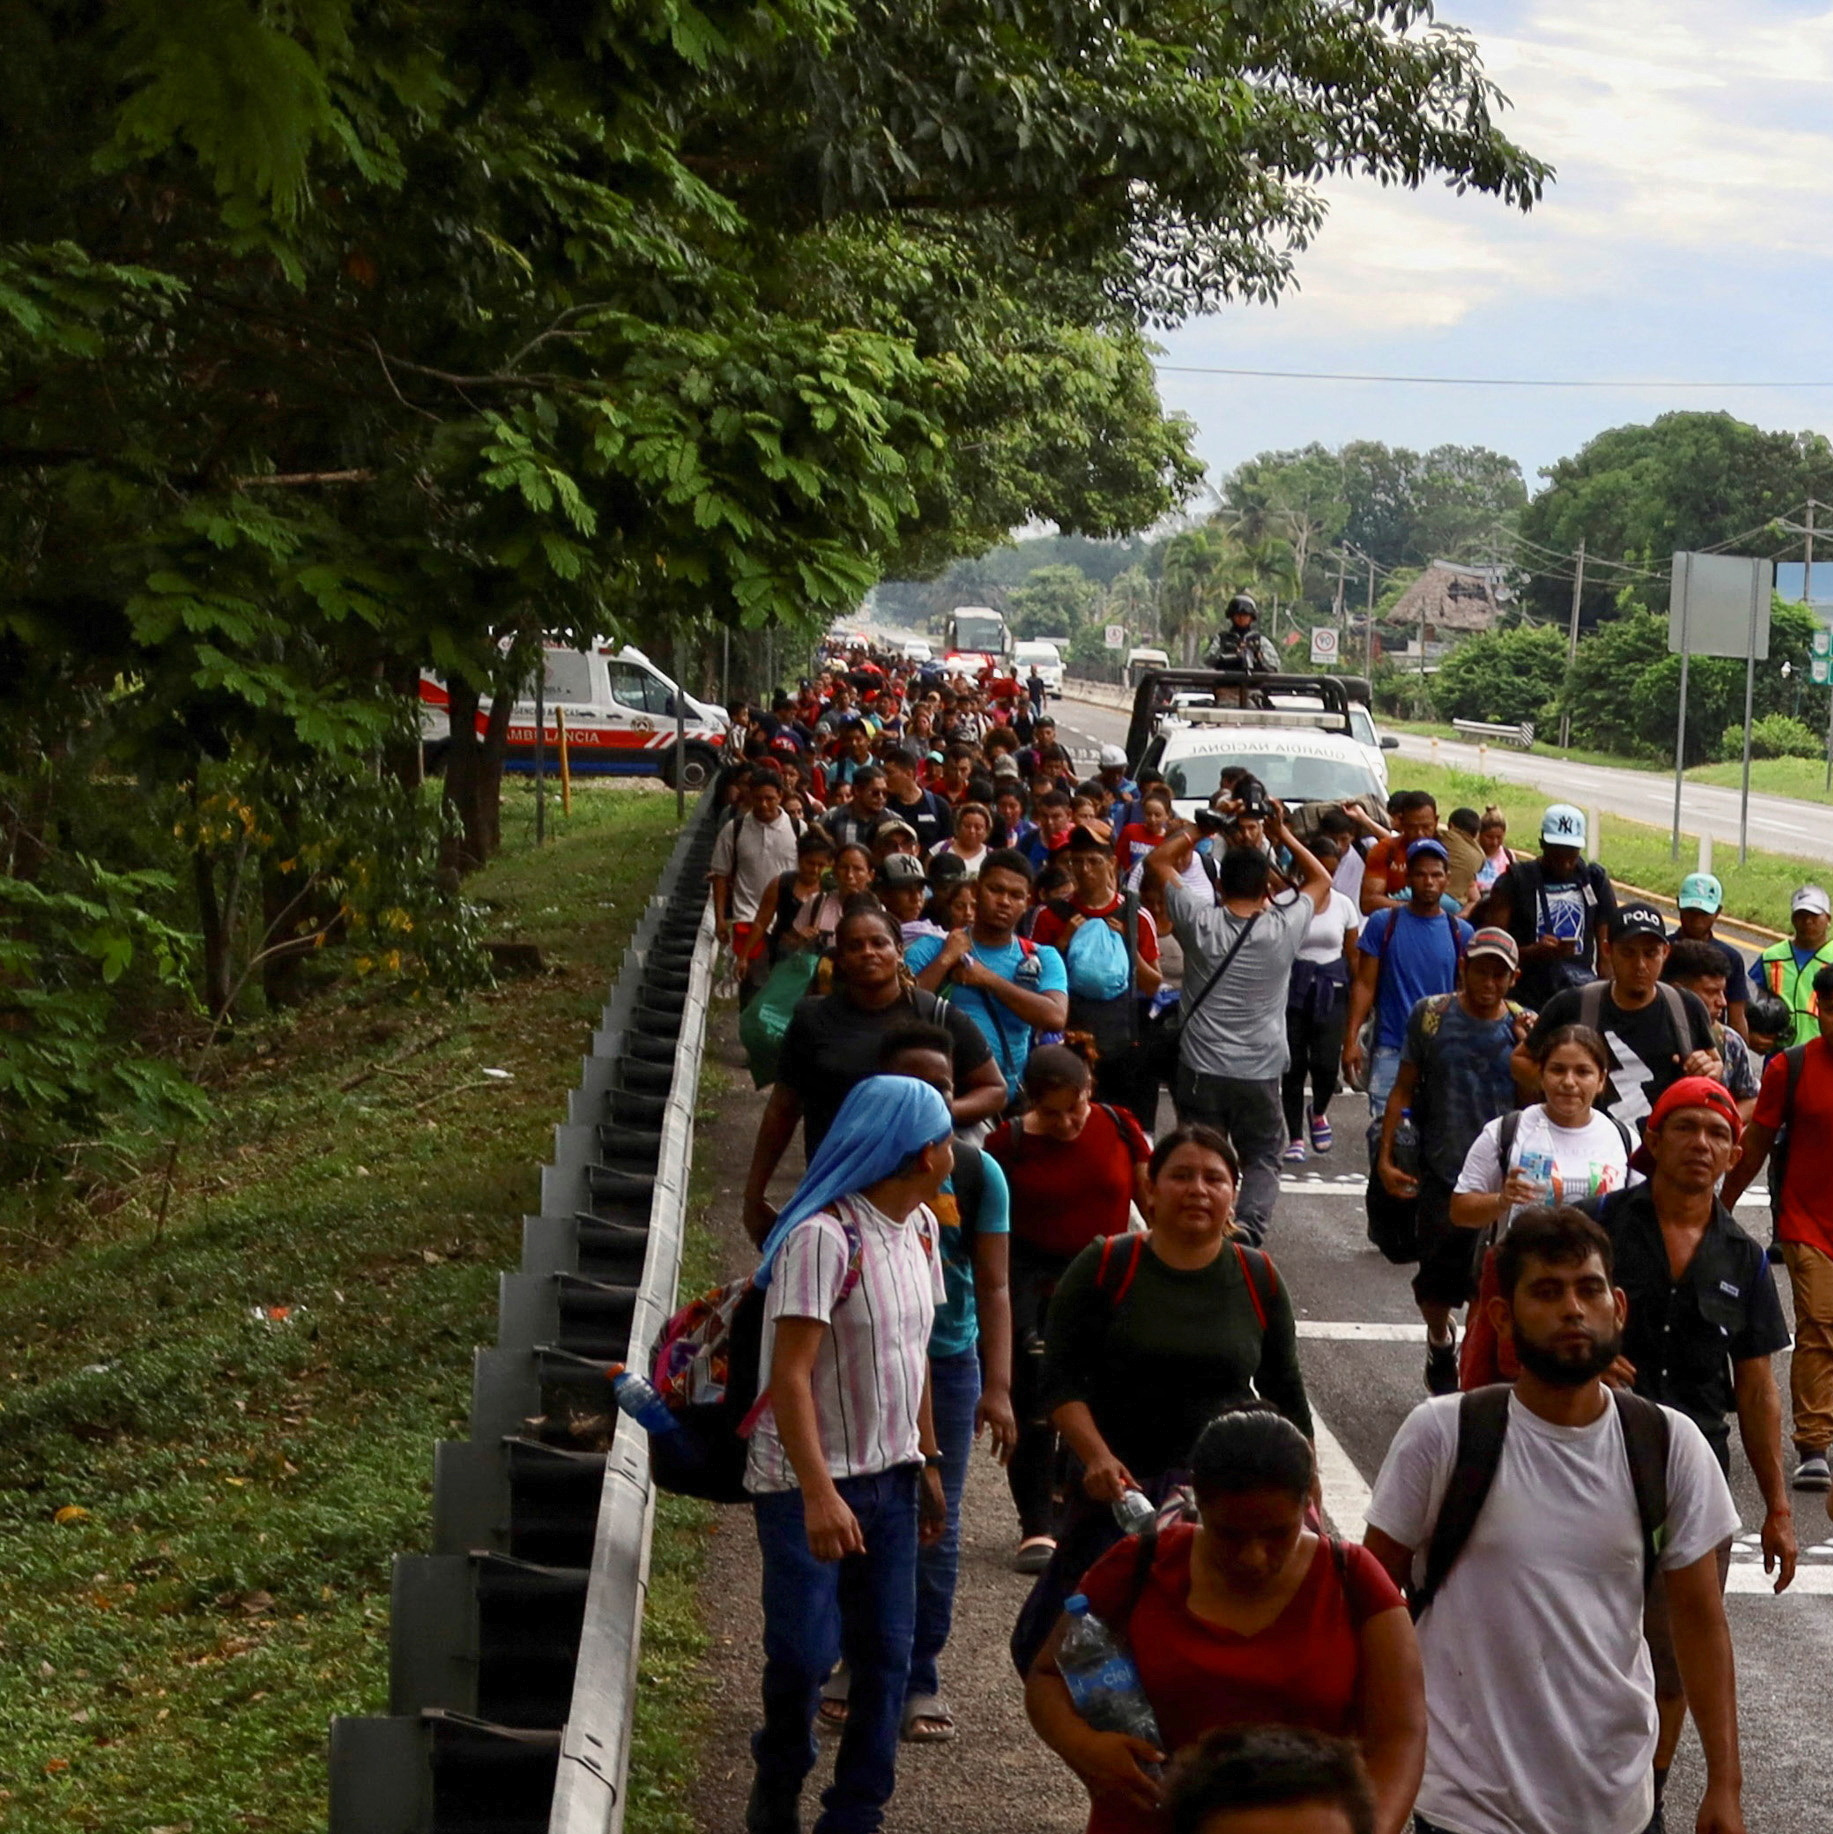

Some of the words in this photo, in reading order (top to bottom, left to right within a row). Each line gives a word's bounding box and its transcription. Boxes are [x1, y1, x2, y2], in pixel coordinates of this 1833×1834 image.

[1319, 635, 1332, 646] 90
[506, 728, 600, 743] MBLNCIA
[1623, 910, 1661, 927] POLO
